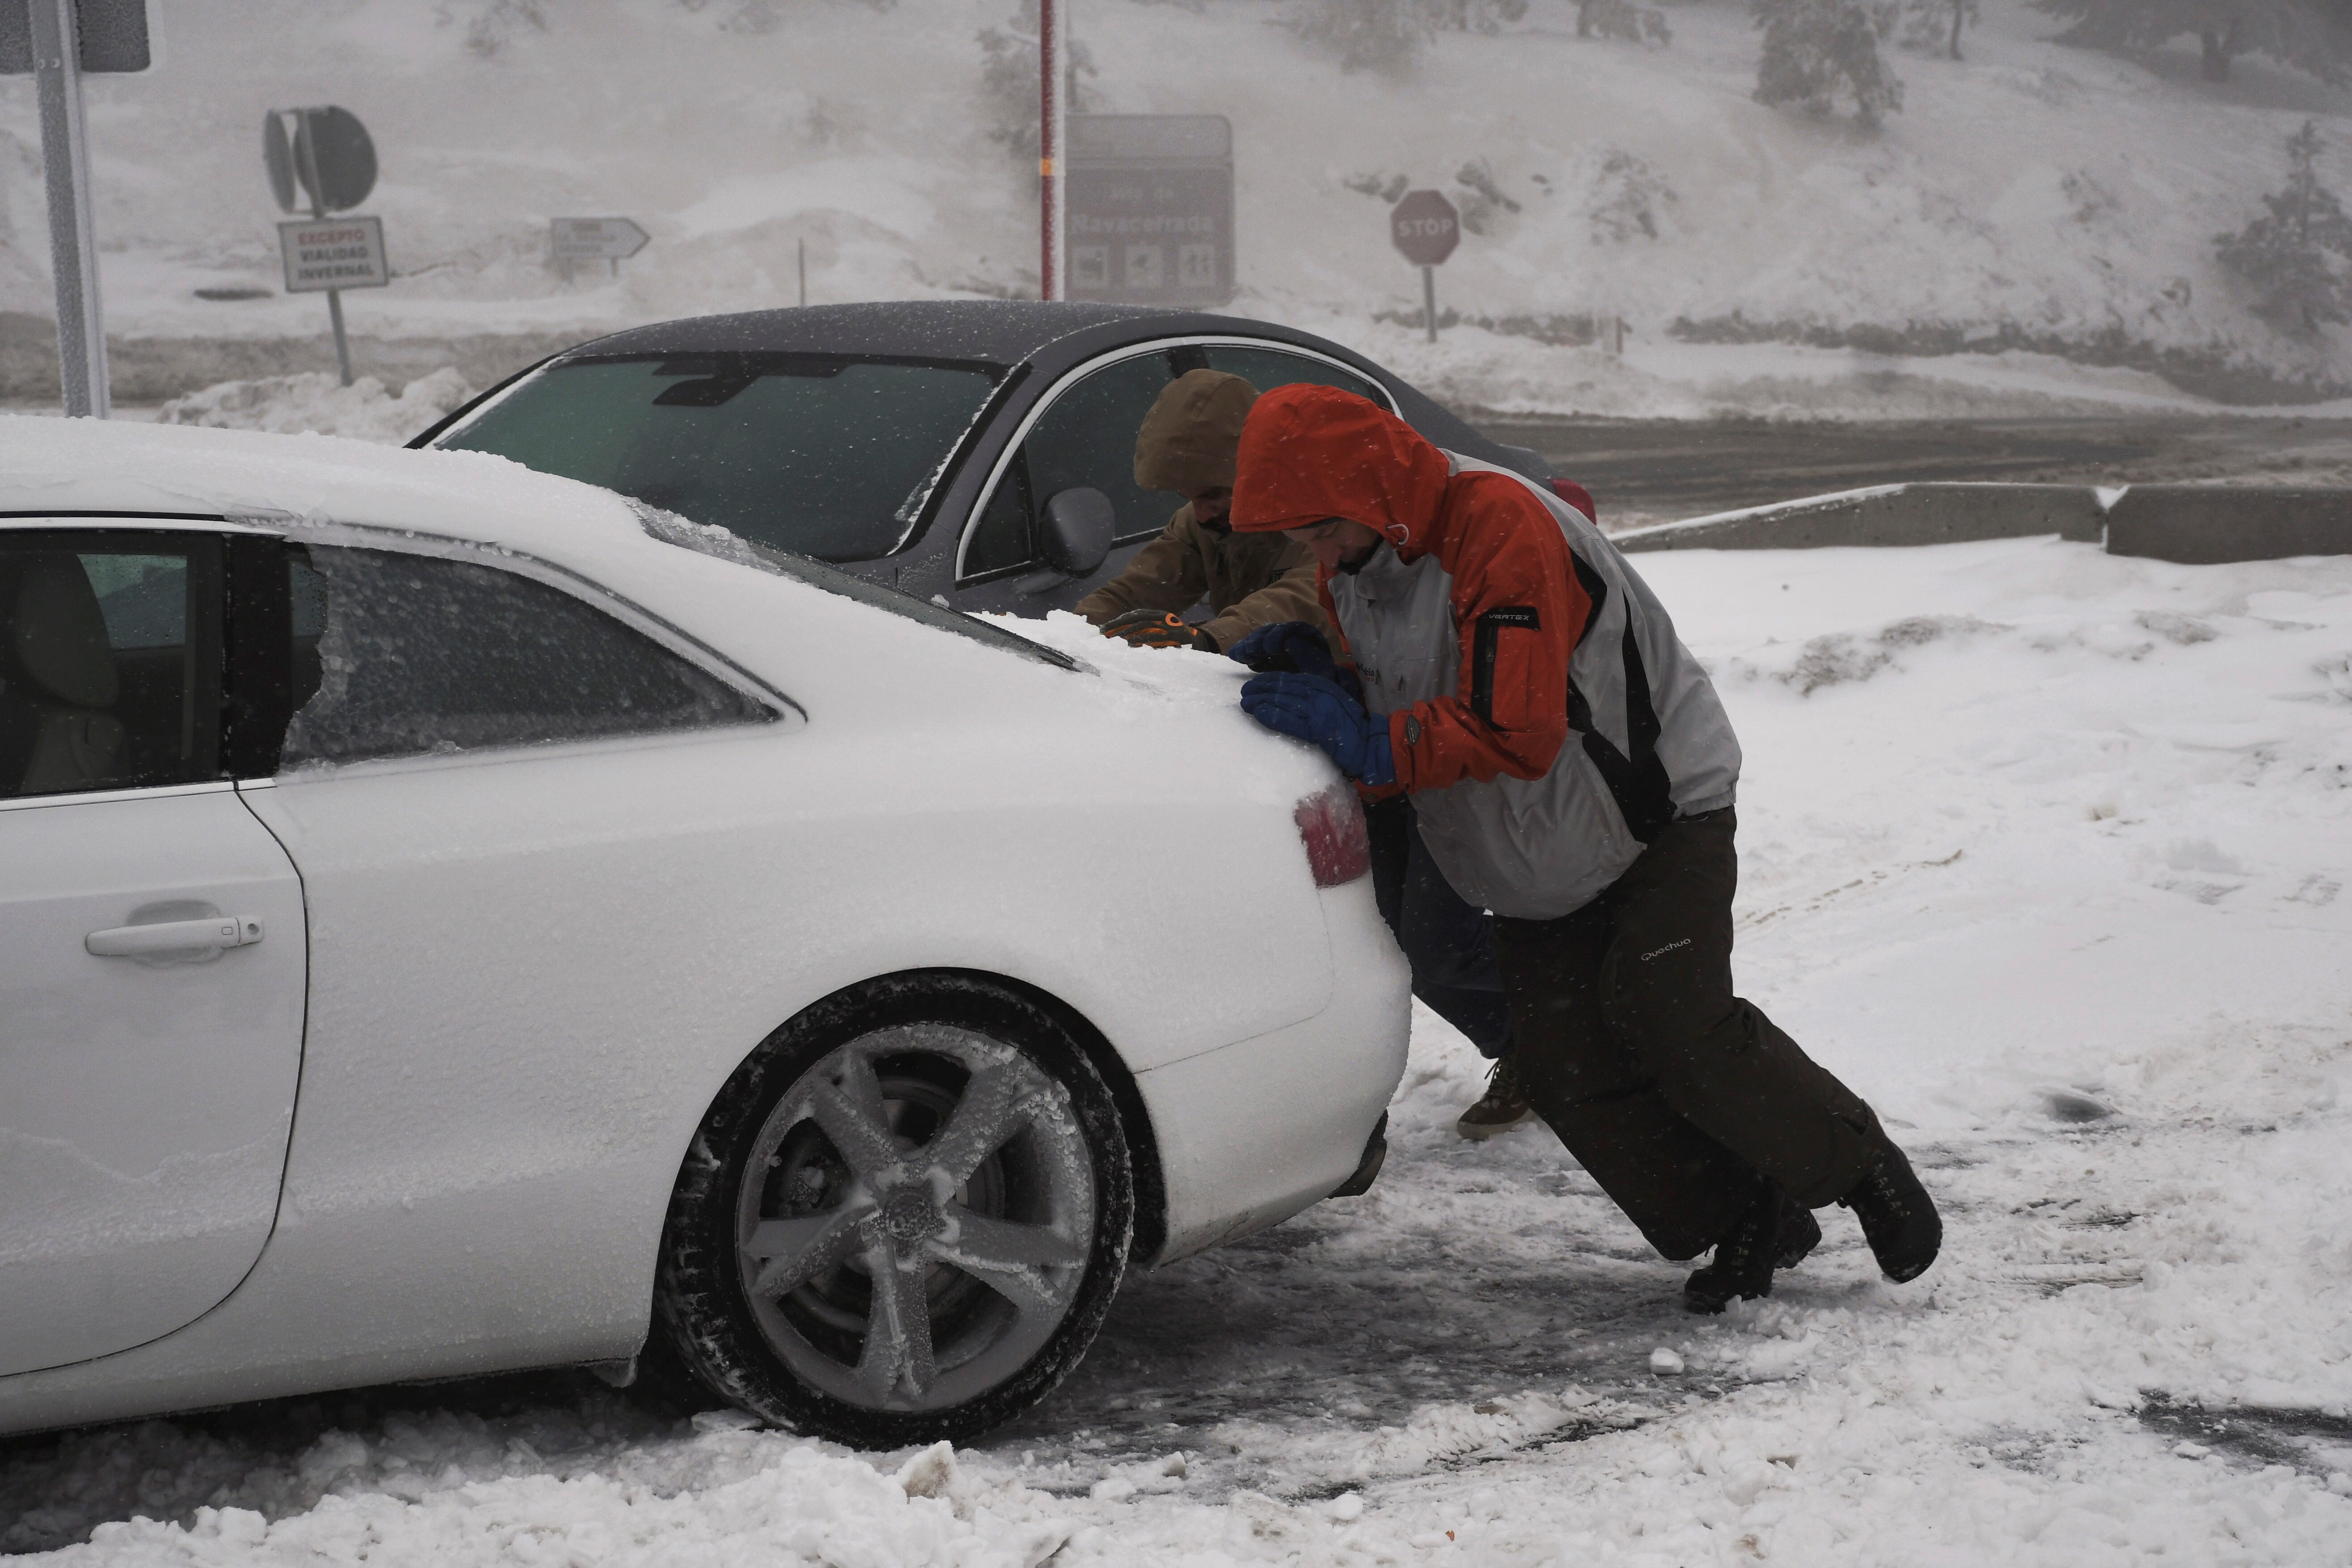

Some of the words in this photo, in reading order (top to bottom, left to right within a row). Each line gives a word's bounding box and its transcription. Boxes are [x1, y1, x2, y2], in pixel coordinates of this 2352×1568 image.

[1071, 213, 1214, 232] Navacerrada
[1398, 218, 1453, 236] STOP
[299, 230, 364, 245] EXCEPTO
[301, 247, 368, 262] VIALIDAD
[298, 264, 374, 279] INVERNAL
